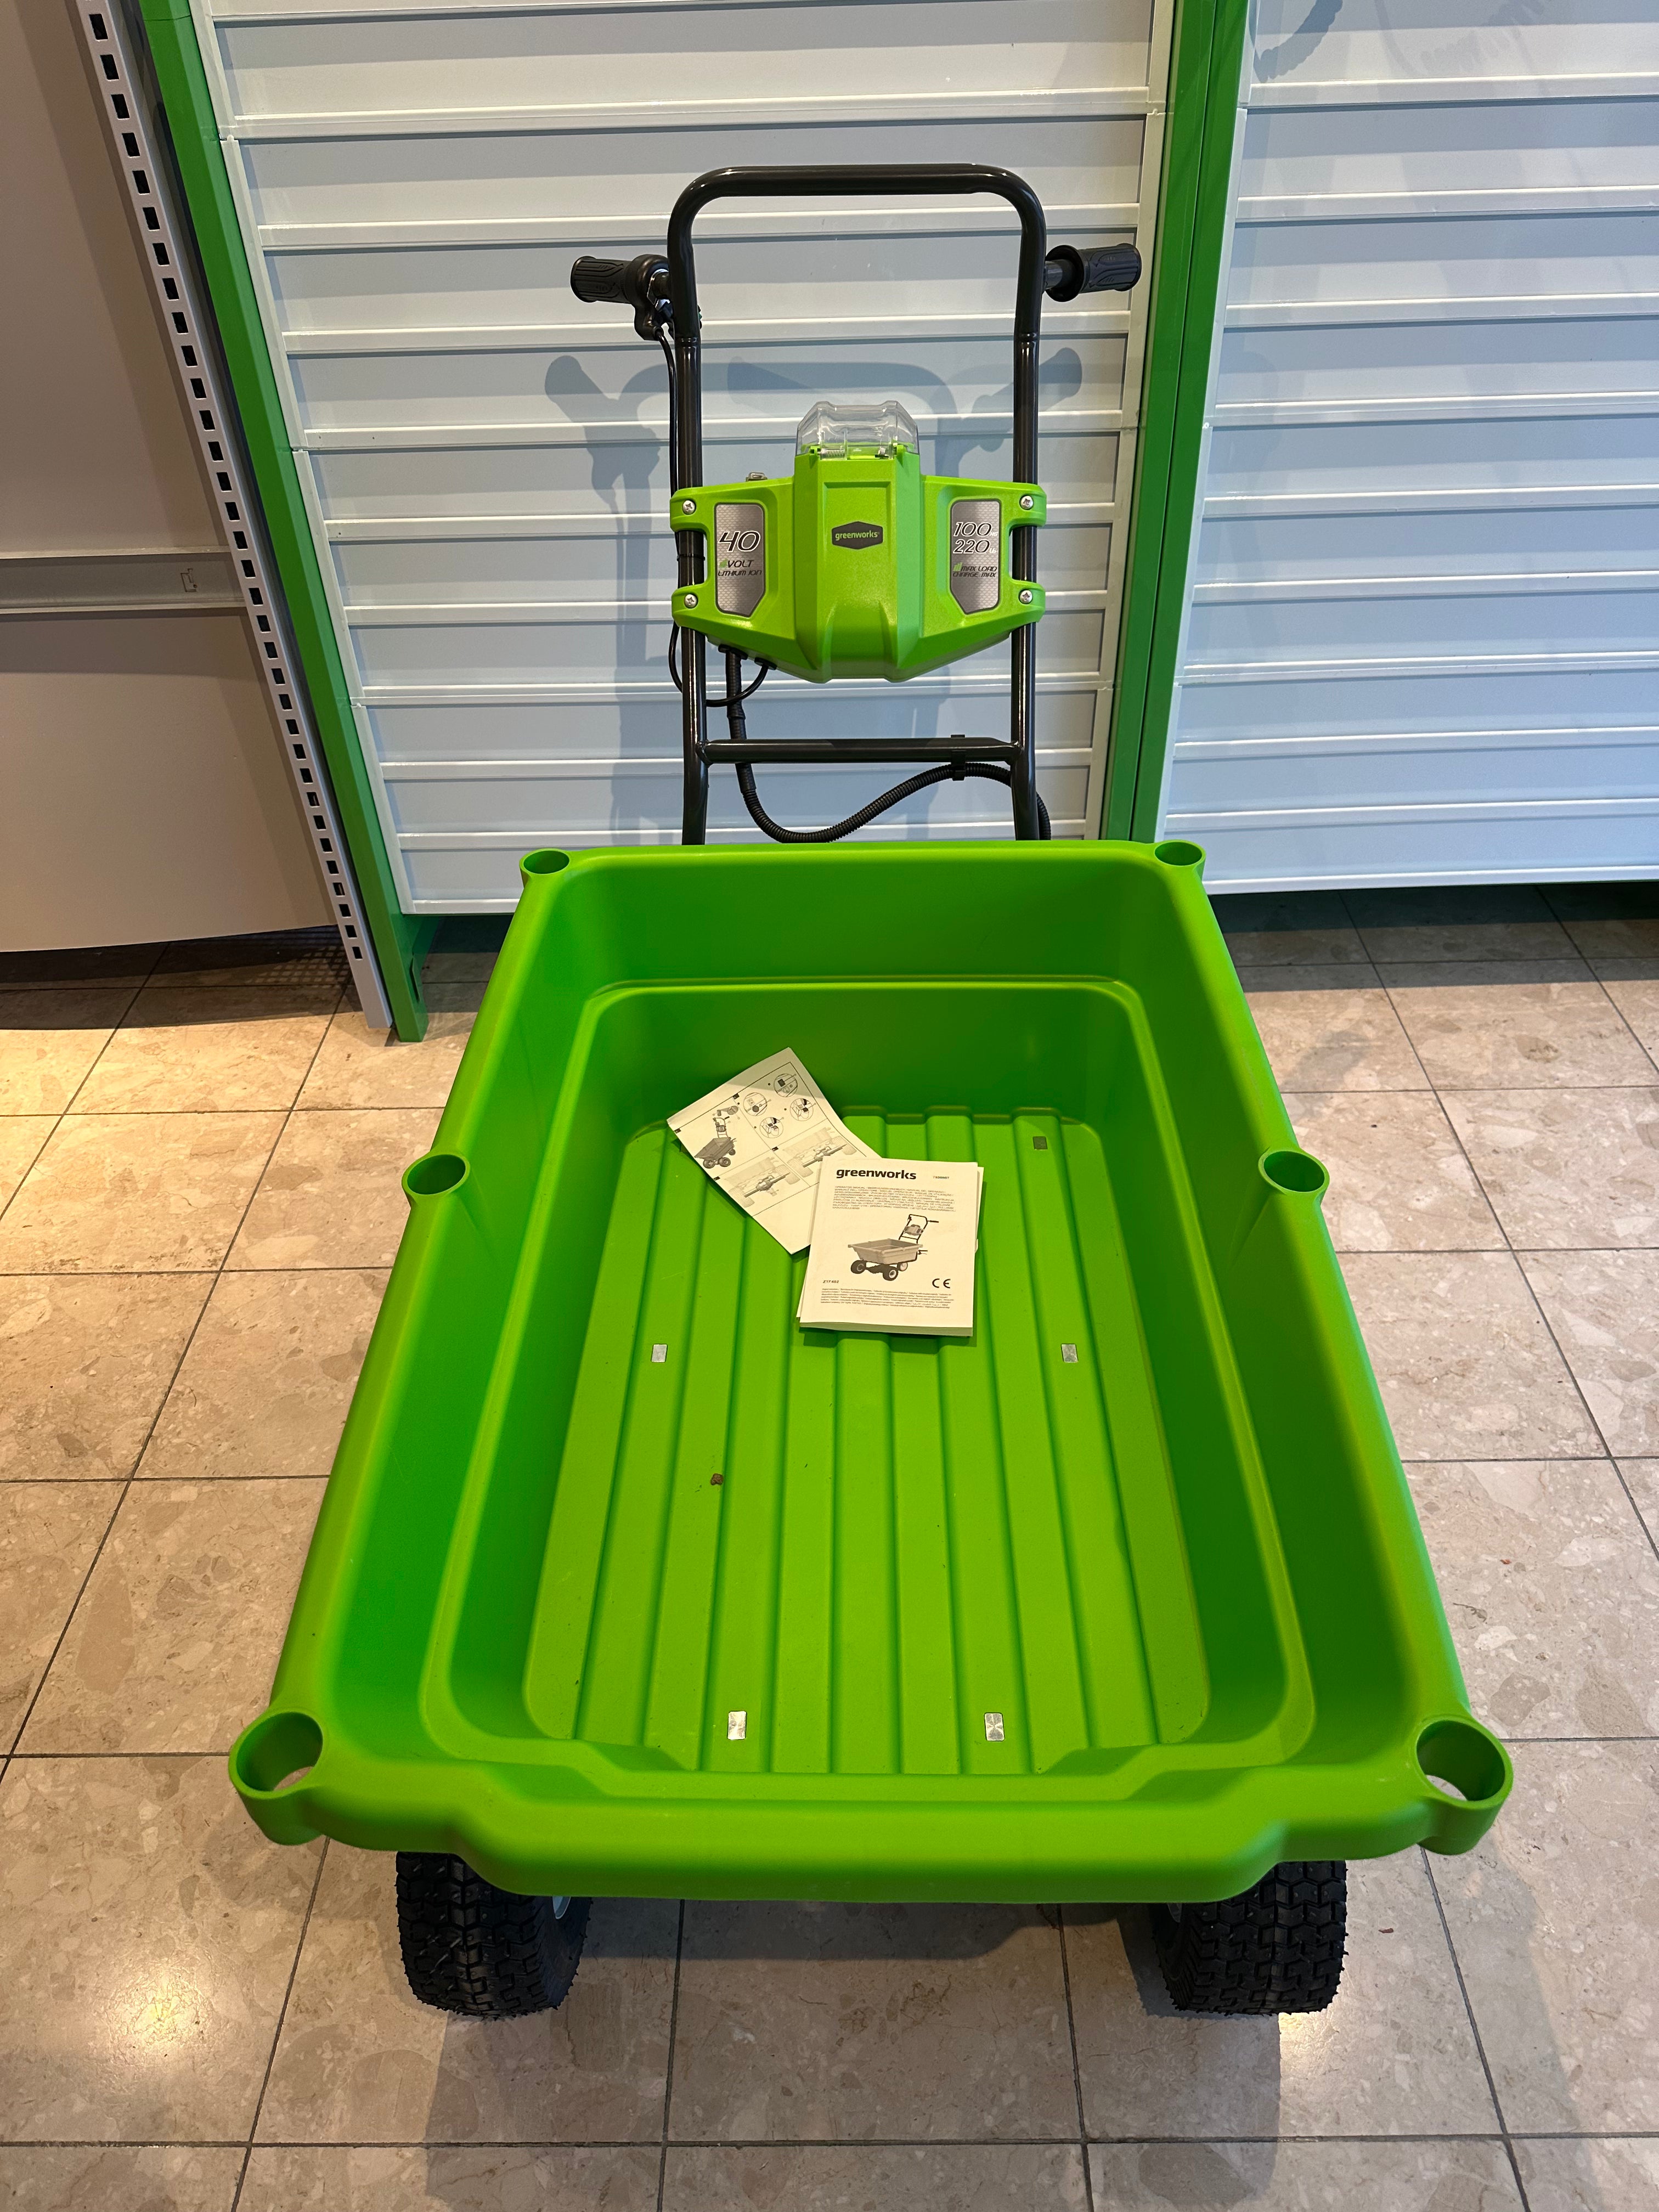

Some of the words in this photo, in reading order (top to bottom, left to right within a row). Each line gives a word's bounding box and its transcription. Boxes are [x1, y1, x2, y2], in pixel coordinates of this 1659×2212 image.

[953, 522, 992, 537] 100
[835, 530, 878, 541] greenworks
[717, 530, 761, 553] 40
[952, 539, 991, 554] 220
[727, 560, 755, 568] VOLT
[836, 1169, 917, 1180] greenworks
[932, 1278, 951, 1289] CE
